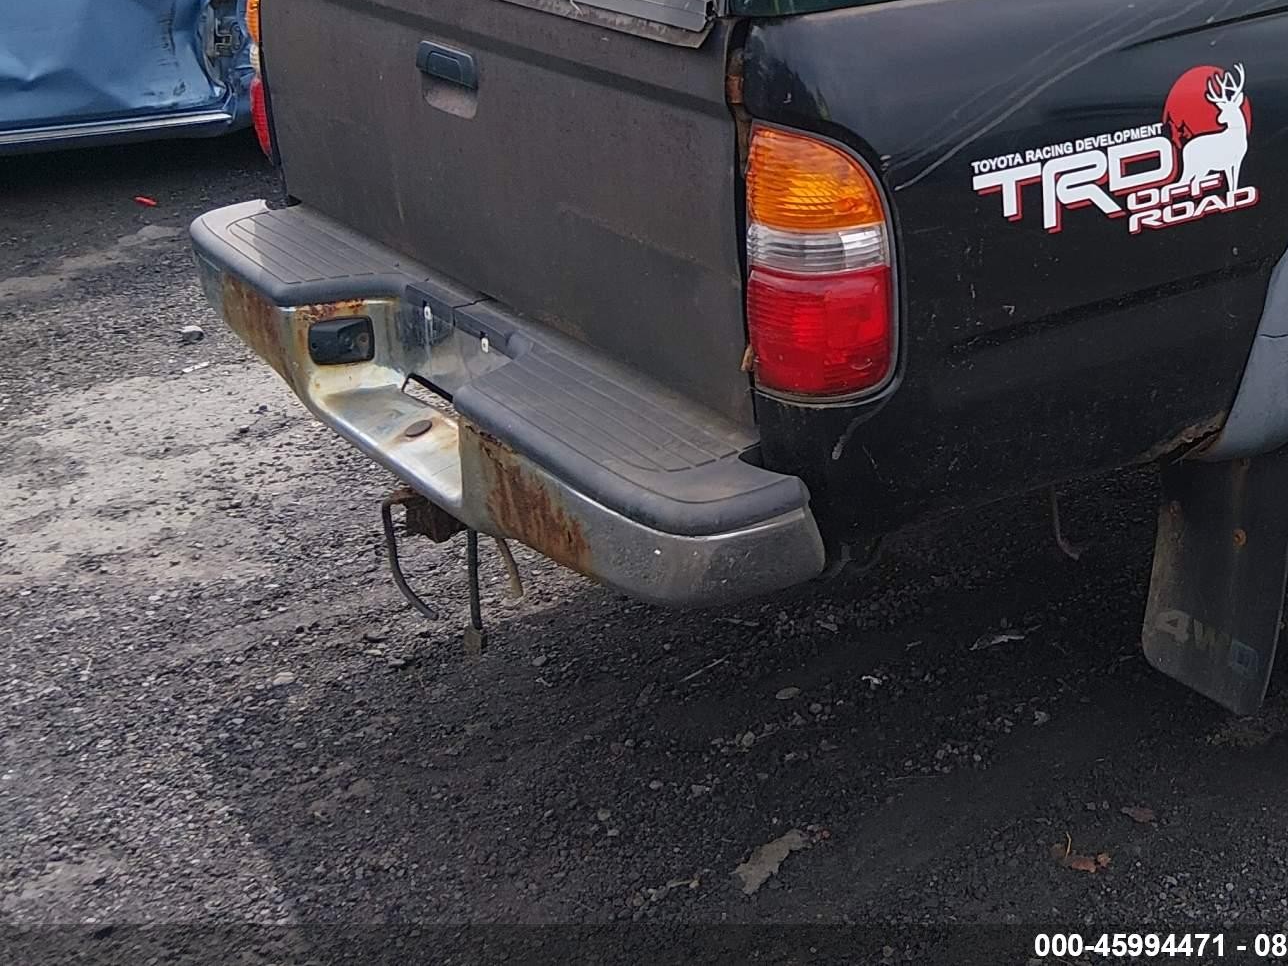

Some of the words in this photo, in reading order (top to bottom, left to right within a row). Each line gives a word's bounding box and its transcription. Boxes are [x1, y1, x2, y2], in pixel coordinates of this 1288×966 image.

[971, 153, 1024, 175] TOYOTA
[1025, 140, 1074, 163] RACING
[1075, 122, 1164, 153] DEVELOPMENT
[972, 136, 1175, 232] TRD
[1126, 171, 1224, 212] OFF
[1128, 185, 1259, 234] ROAD
